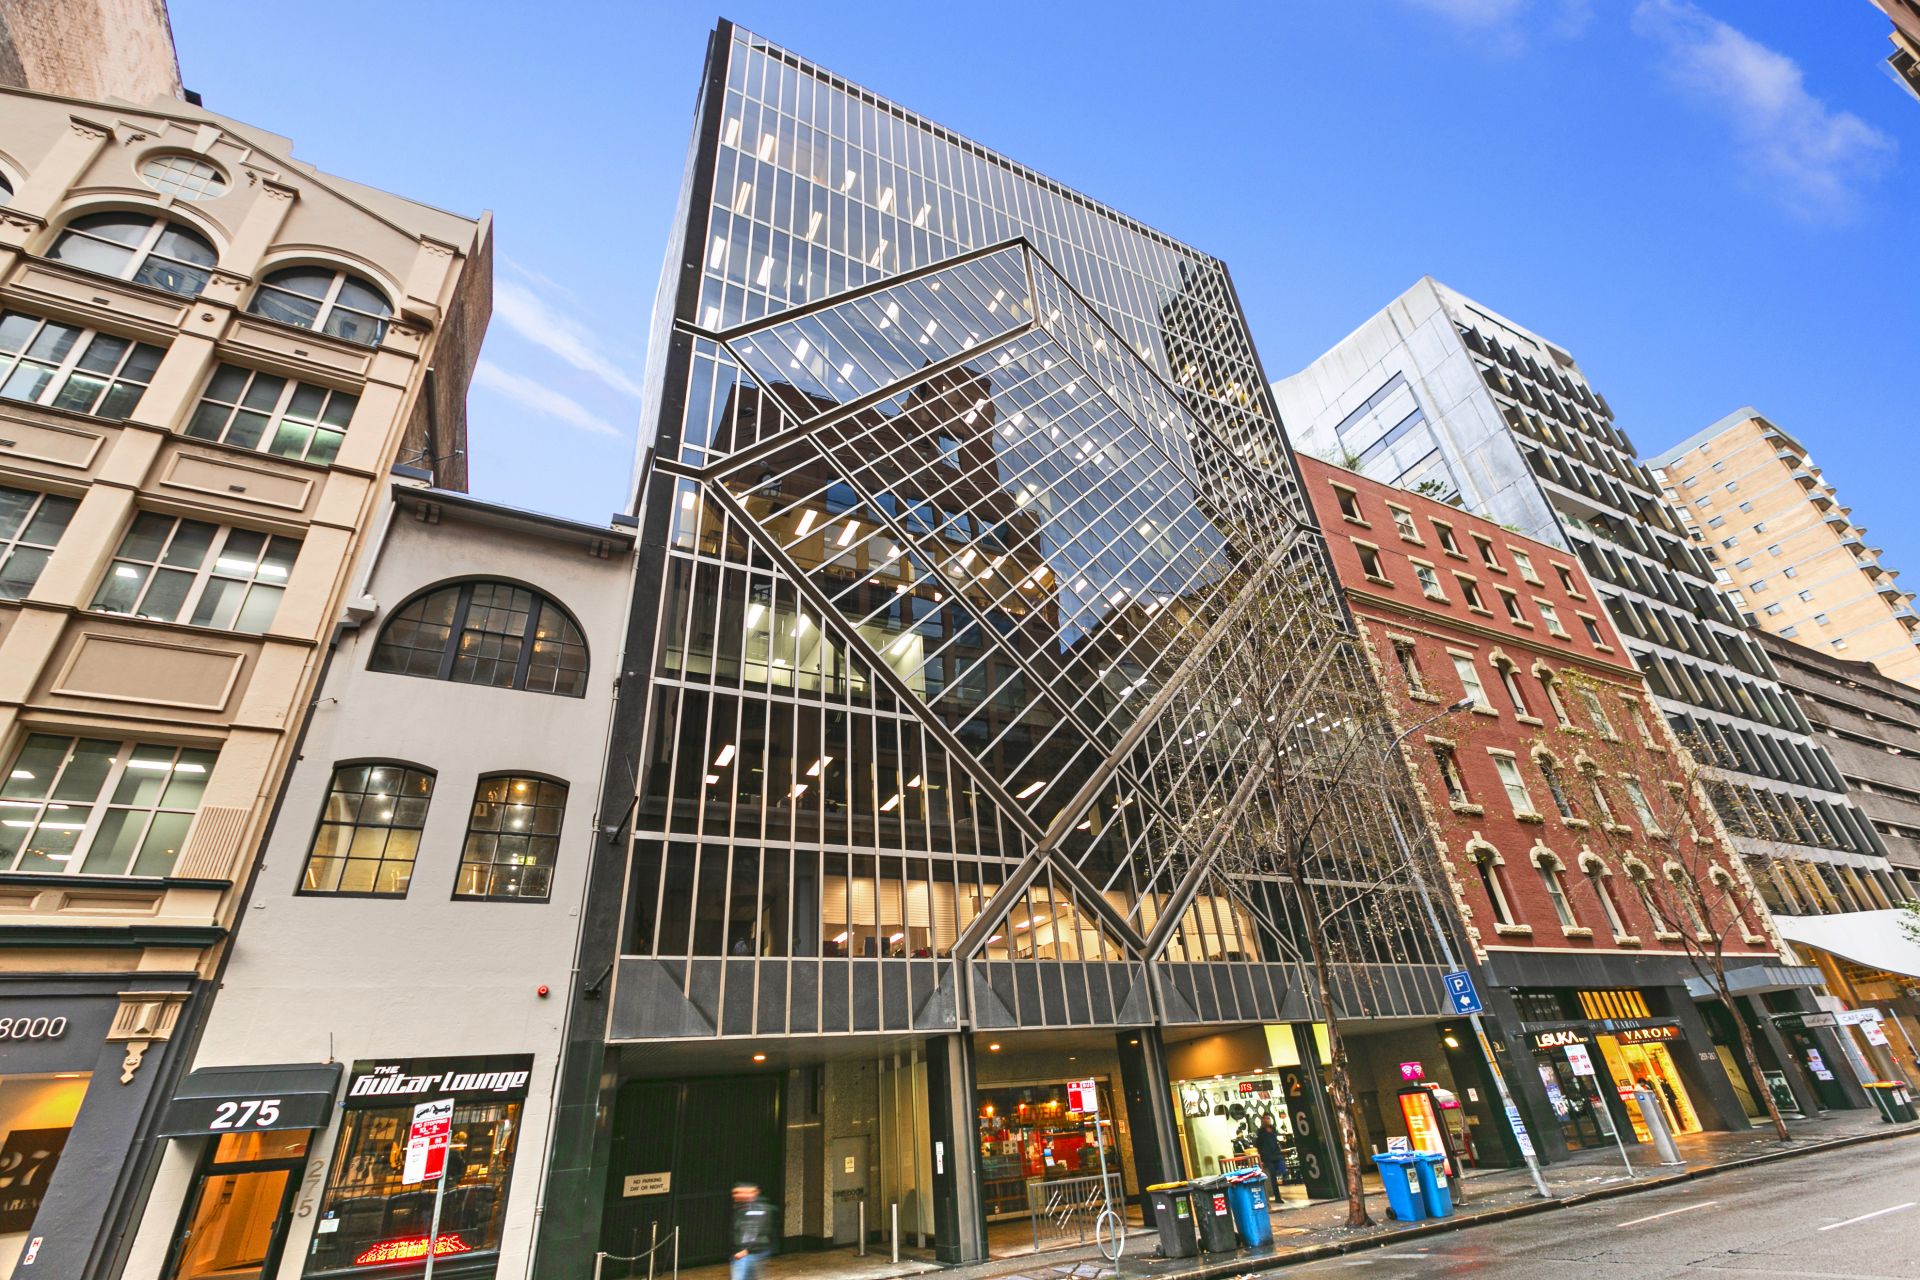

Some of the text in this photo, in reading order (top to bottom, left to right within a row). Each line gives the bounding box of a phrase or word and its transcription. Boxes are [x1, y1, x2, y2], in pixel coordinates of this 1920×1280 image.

[1454, 979, 1463, 991] P
[1623, 1027, 1672, 1040] VAROA
[374, 1065, 400, 1074] THE
[350, 1073, 442, 1096] Guitar
[210, 1100, 281, 1129] 275
[0, 1150, 60, 1188] 27
